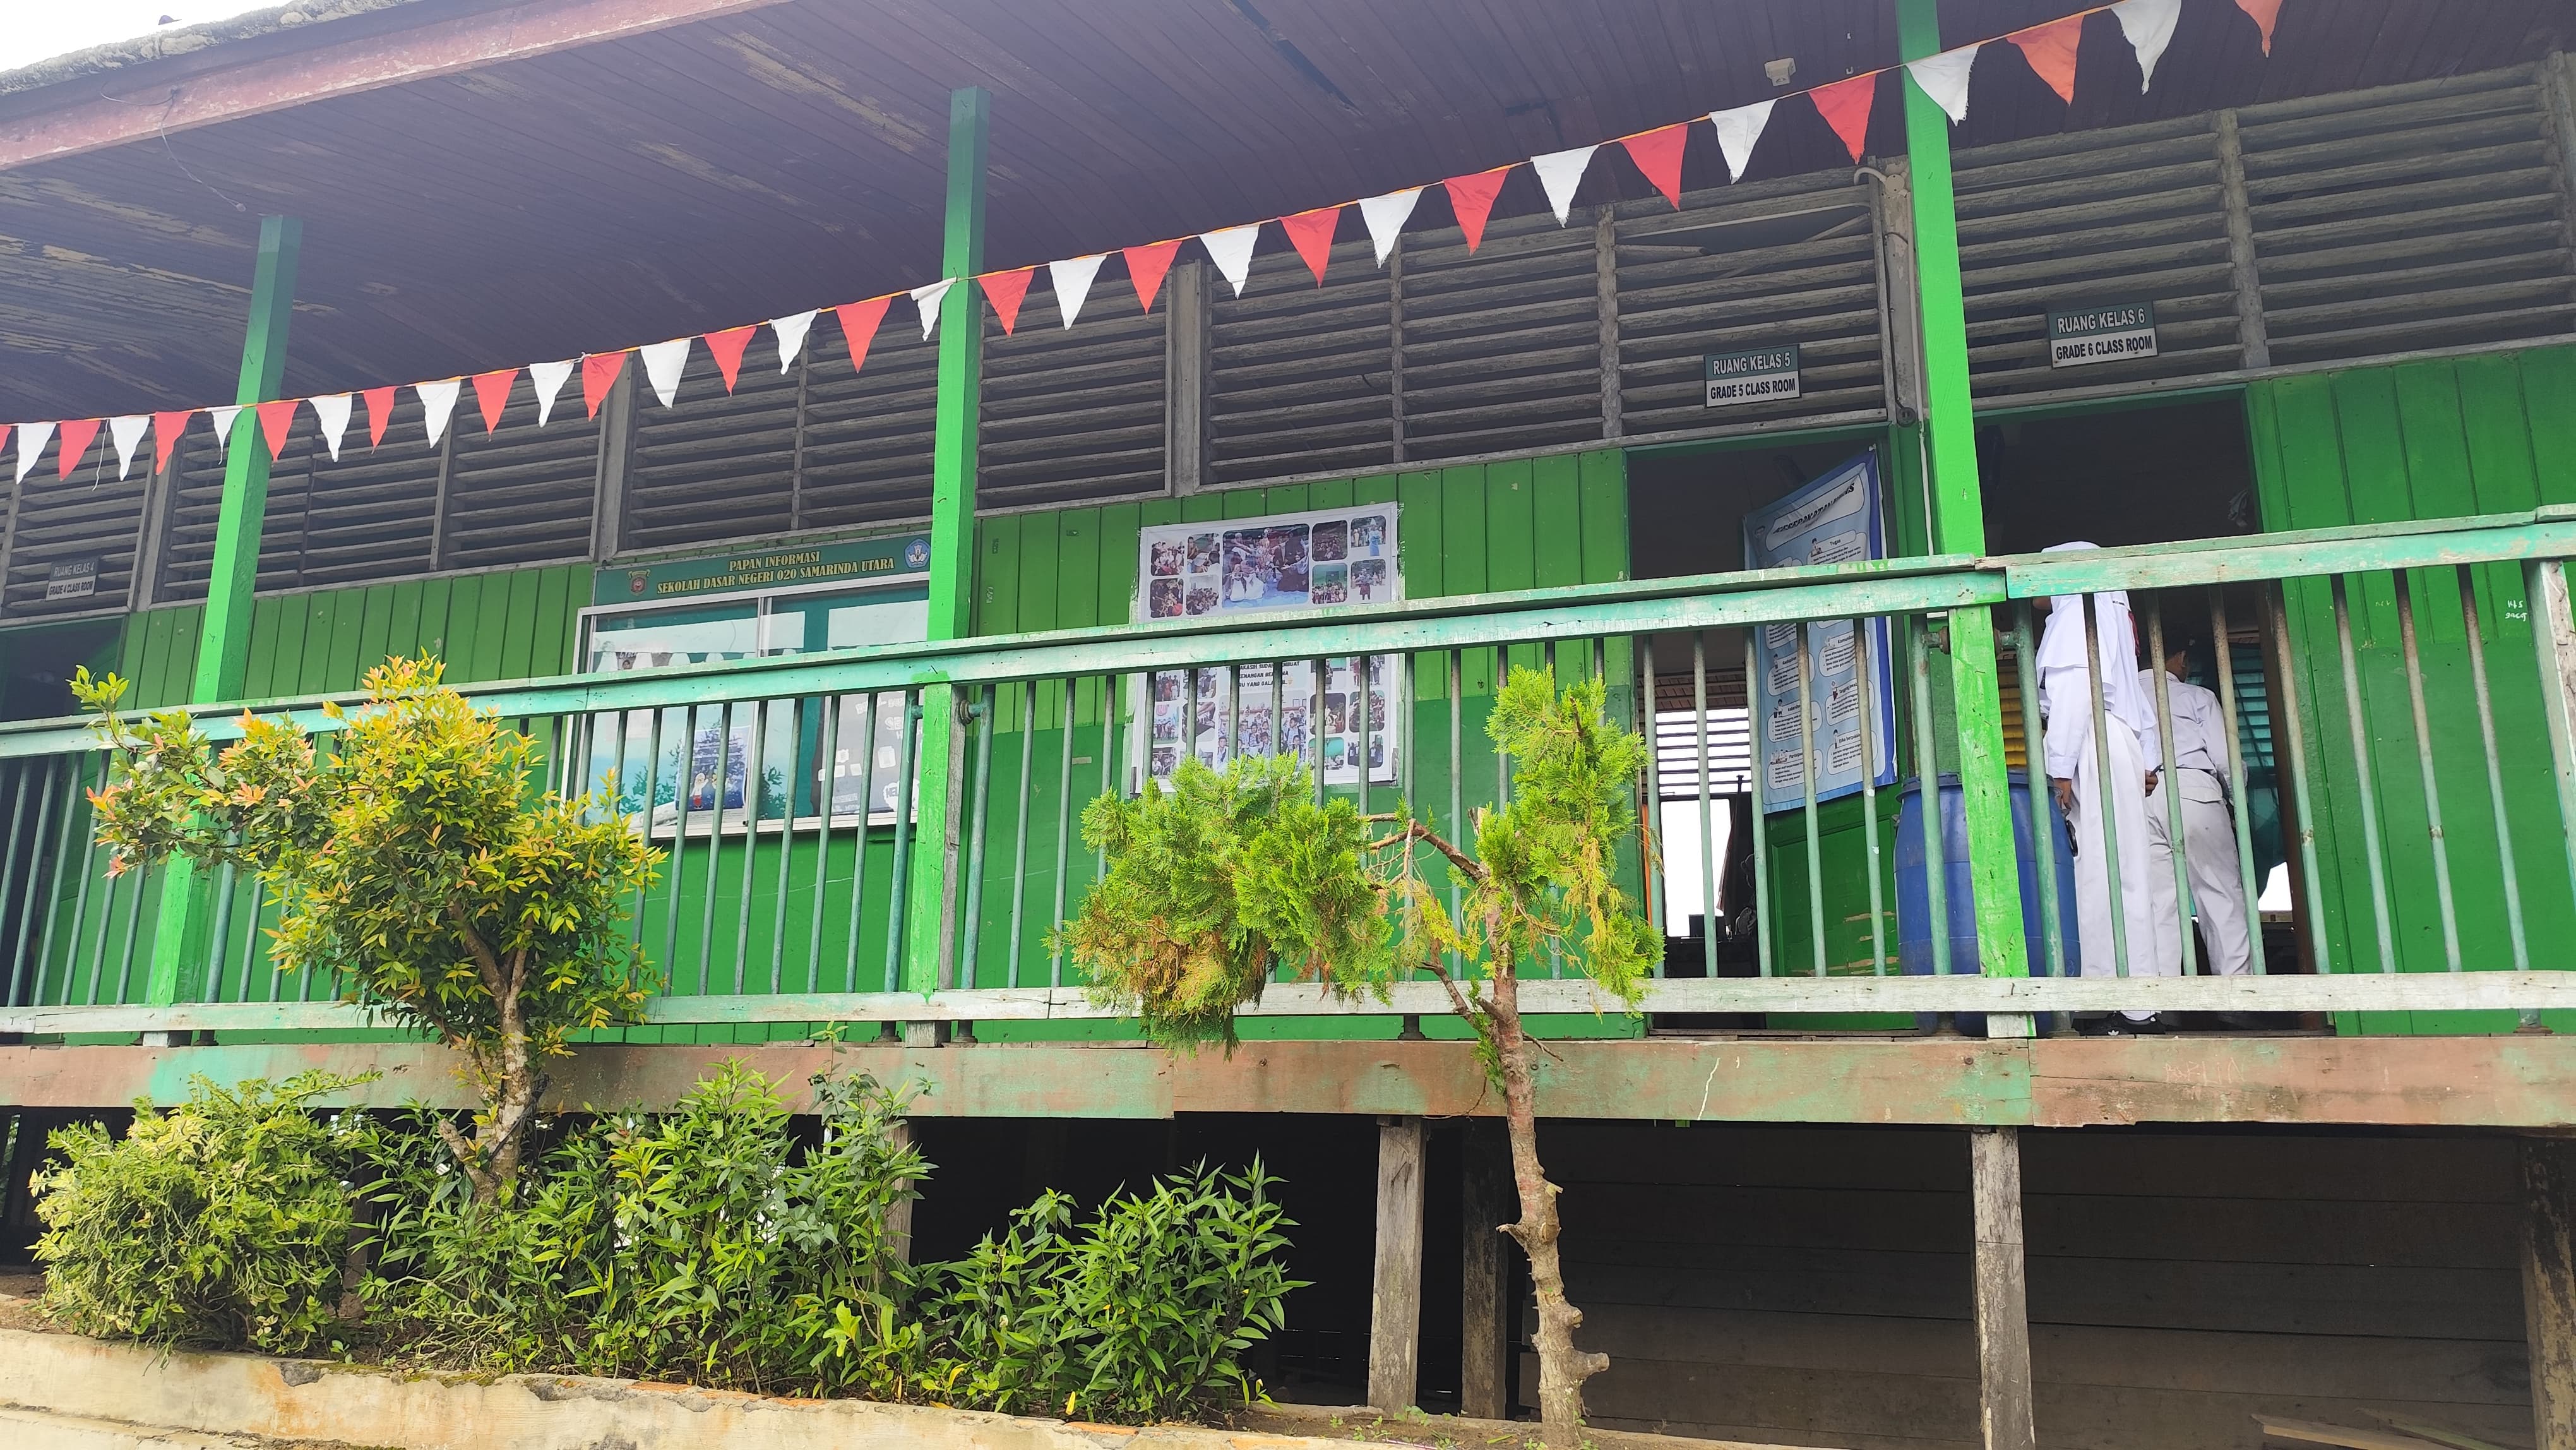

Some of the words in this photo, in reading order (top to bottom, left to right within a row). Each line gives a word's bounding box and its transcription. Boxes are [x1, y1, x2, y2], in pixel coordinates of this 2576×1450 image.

[2057, 314, 2096, 333] RUANG
[2099, 309, 2135, 328] KELAS
[2138, 308, 2145, 324] 6
[2056, 344, 2085, 360] GRADE
[2088, 342, 2094, 356] 6
[2096, 339, 2124, 355] CLASS
[2126, 335, 2153, 352] ROOM
[1713, 357, 1747, 375] RUANG
[1750, 353, 1782, 371] KELAS
[1784, 352, 1791, 367] 5
[1711, 385, 1736, 399] GRADE
[1739, 384, 1743, 397] 5
[1746, 381, 1770, 396] CLASS
[1772, 378, 1796, 393] ROOM
[54, 565, 73, 577] RUANG
[73, 562, 90, 575] KELAS
[90, 561, 95, 572] 4
[729, 558, 761, 572] PAPAN
[765, 551, 820, 568] INFORMASI
[657, 578, 700, 594] SEKOLAH
[703, 575, 735, 589] DASAR
[738, 570, 774, 585] NEGERI
[777, 568, 797, 581] 020
[800, 561, 858, 578] SAMARINDA
[861, 558, 895, 572] UTARA
[49, 584, 64, 596] GRADE
[67, 582, 80, 593] CLASS
[81, 581, 93, 592] ROOM
